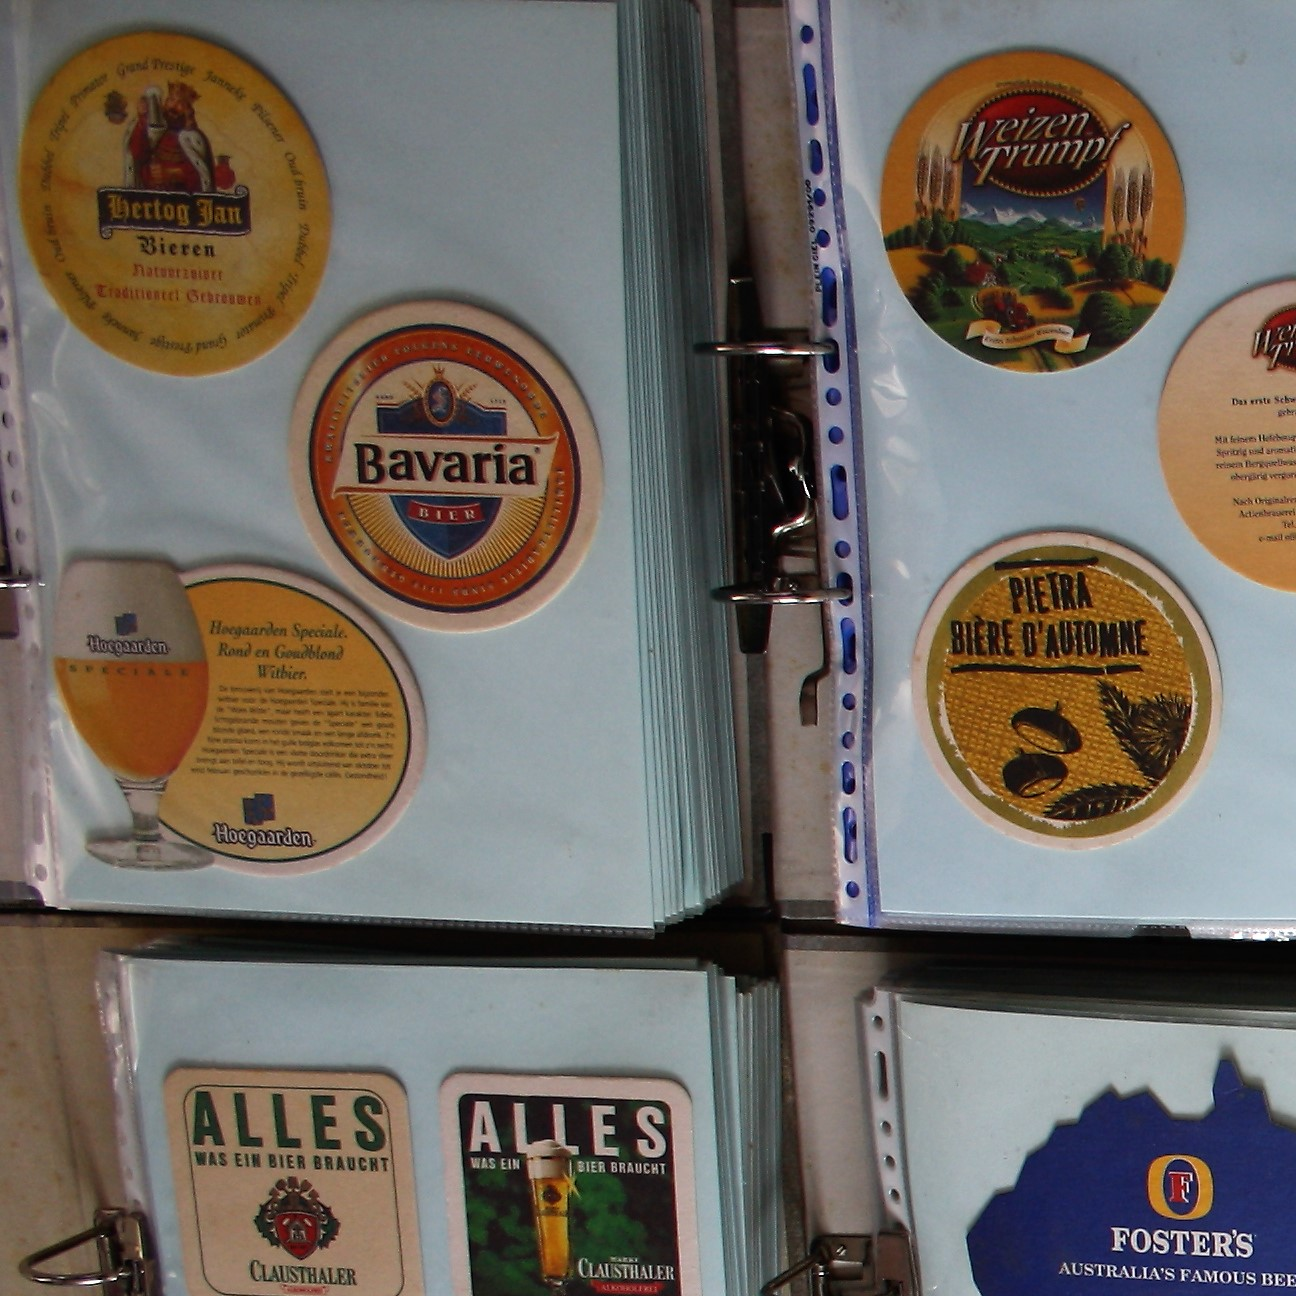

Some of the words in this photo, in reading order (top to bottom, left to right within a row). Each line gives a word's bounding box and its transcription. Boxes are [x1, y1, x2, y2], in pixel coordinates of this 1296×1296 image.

[953, 107, 1090, 162] Weizen
[973, 123, 1132, 186] Trumpf
[109, 195, 188, 225] Hertog
[197, 200, 242, 225] Jan
[136, 235, 216, 256] Bieren
[354, 443, 538, 486] Bavaria
[418, 507, 476, 521] BIER
[1009, 572, 1094, 614] PIETRA
[210, 621, 286, 641] Hoegaarden
[292, 624, 347, 640] Speciale.
[1021, 619, 1148, 658] D'AUTOMNE
[88, 635, 168, 655] Hoegaarden
[218, 644, 251, 659] Rond
[256, 648, 270, 659] en
[275, 644, 344, 660] Goudblond
[68, 664, 191, 678] SPECIALE
[257, 664, 307, 680] Witbier.
[215, 824, 312, 848] Hoegaarden
[193, 1090, 387, 1152] ALLES
[469, 1101, 667, 1159] ALLES
[194, 1151, 228, 1167] WAS
[235, 1152, 261, 1168] EIN
[268, 1154, 306, 1170] BIER
[313, 1155, 389, 1172] BRAUCHT
[470, 1158, 496, 1170] WAS
[501, 1159, 520, 1171] EIN
[578, 1161, 606, 1174] BIER
[611, 1162, 666, 1175] BRAUCHT
[1110, 1227, 1254, 1258] FOSTER'S
[250, 1259, 358, 1286] CLAUSTHALER
[577, 1257, 675, 1281] CLAUSTHALER
[1059, 1262, 1175, 1281] AUSTRALIA'S
[1180, 1268, 1256, 1286] FAMOUS
